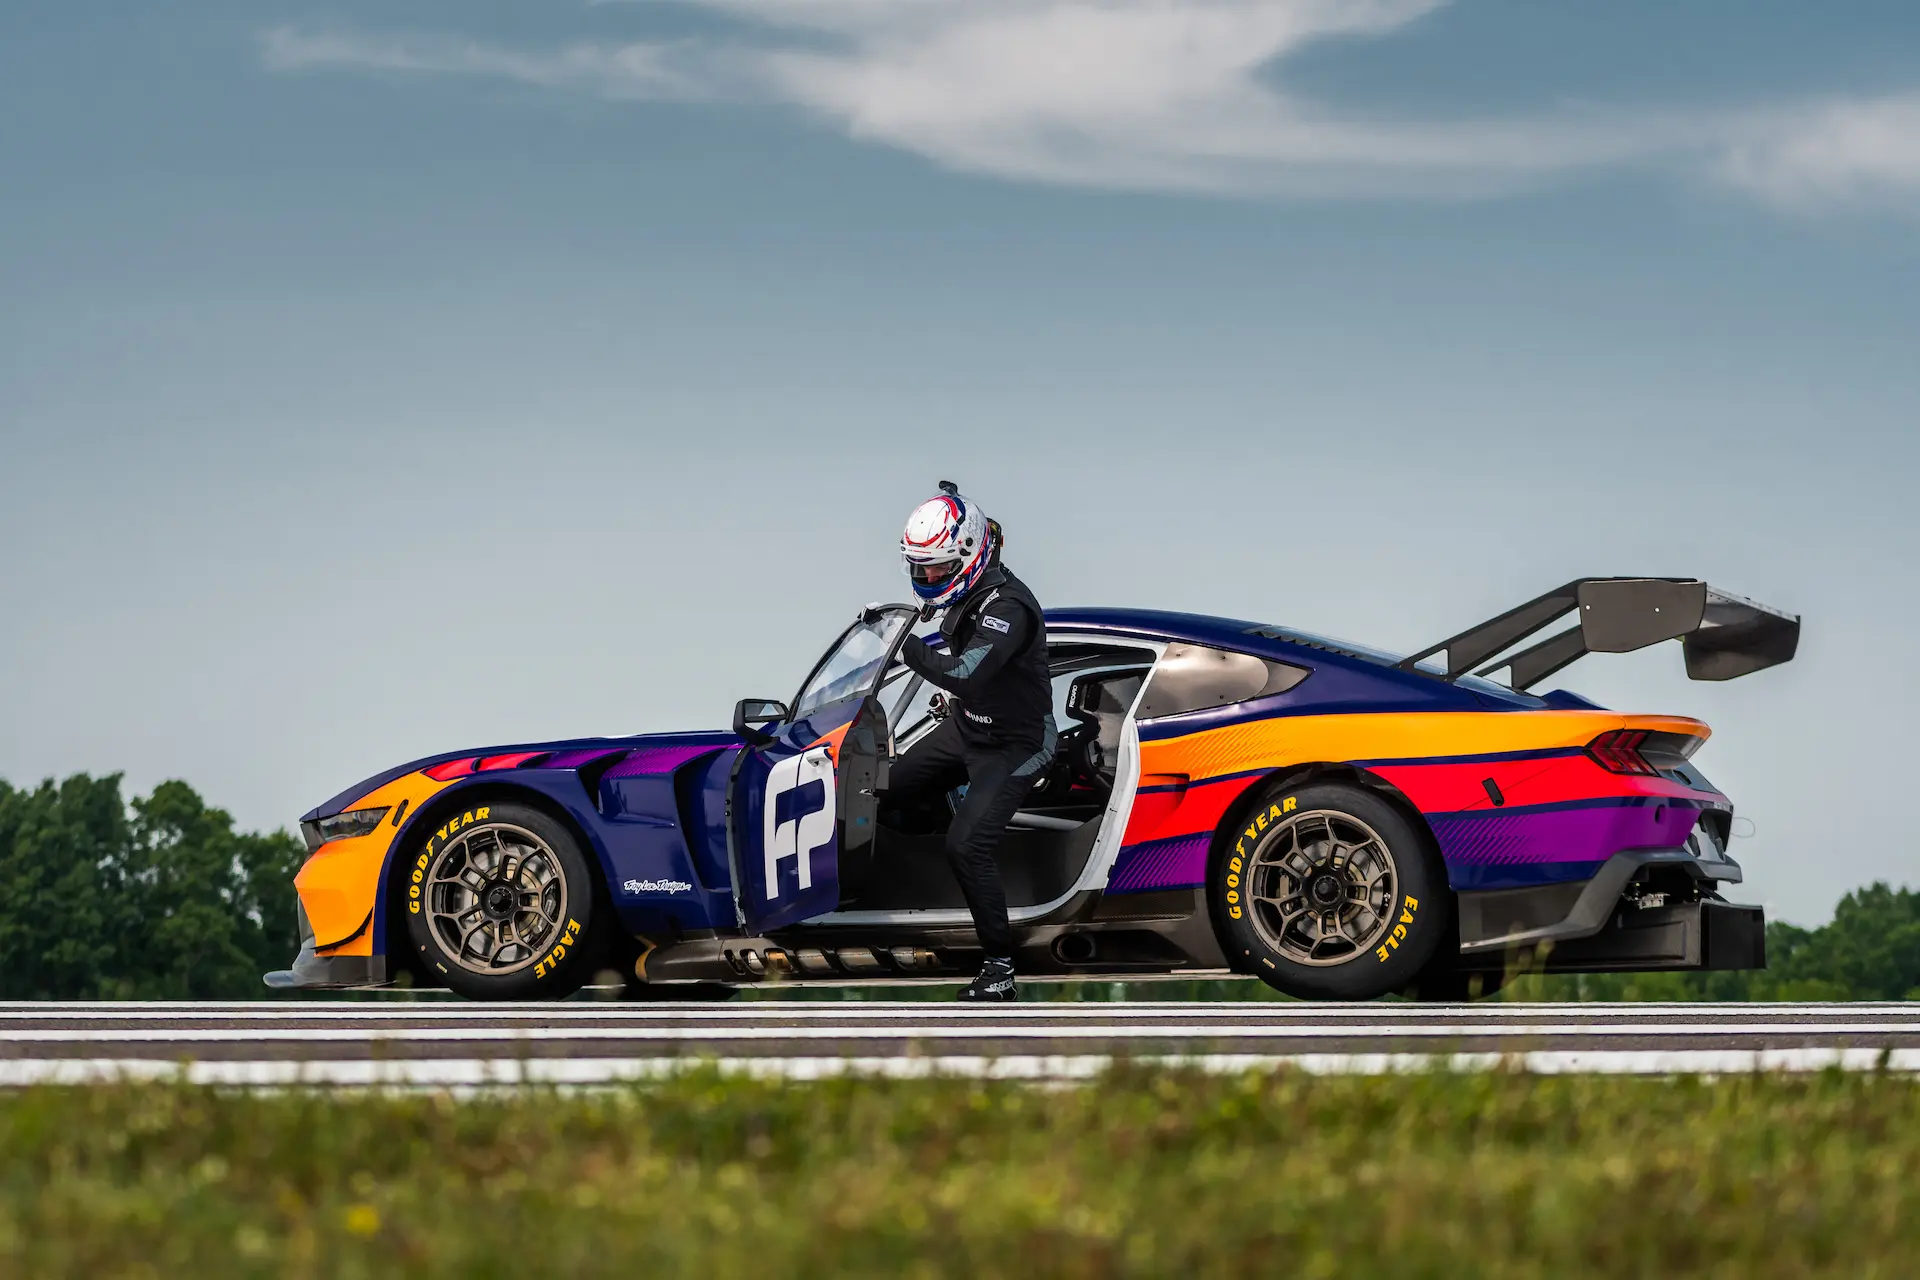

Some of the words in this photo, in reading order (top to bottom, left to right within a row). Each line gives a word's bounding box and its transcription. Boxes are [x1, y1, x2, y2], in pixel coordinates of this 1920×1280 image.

[1068, 684, 1078, 708] RECARO
[408, 806, 490, 914] GOODYEAR
[643, 879, 657, 891] Lee
[1226, 796, 1297, 920] GOODYEAR
[533, 918, 581, 979] EAGLE
[1375, 895, 1419, 963] EAGLE
